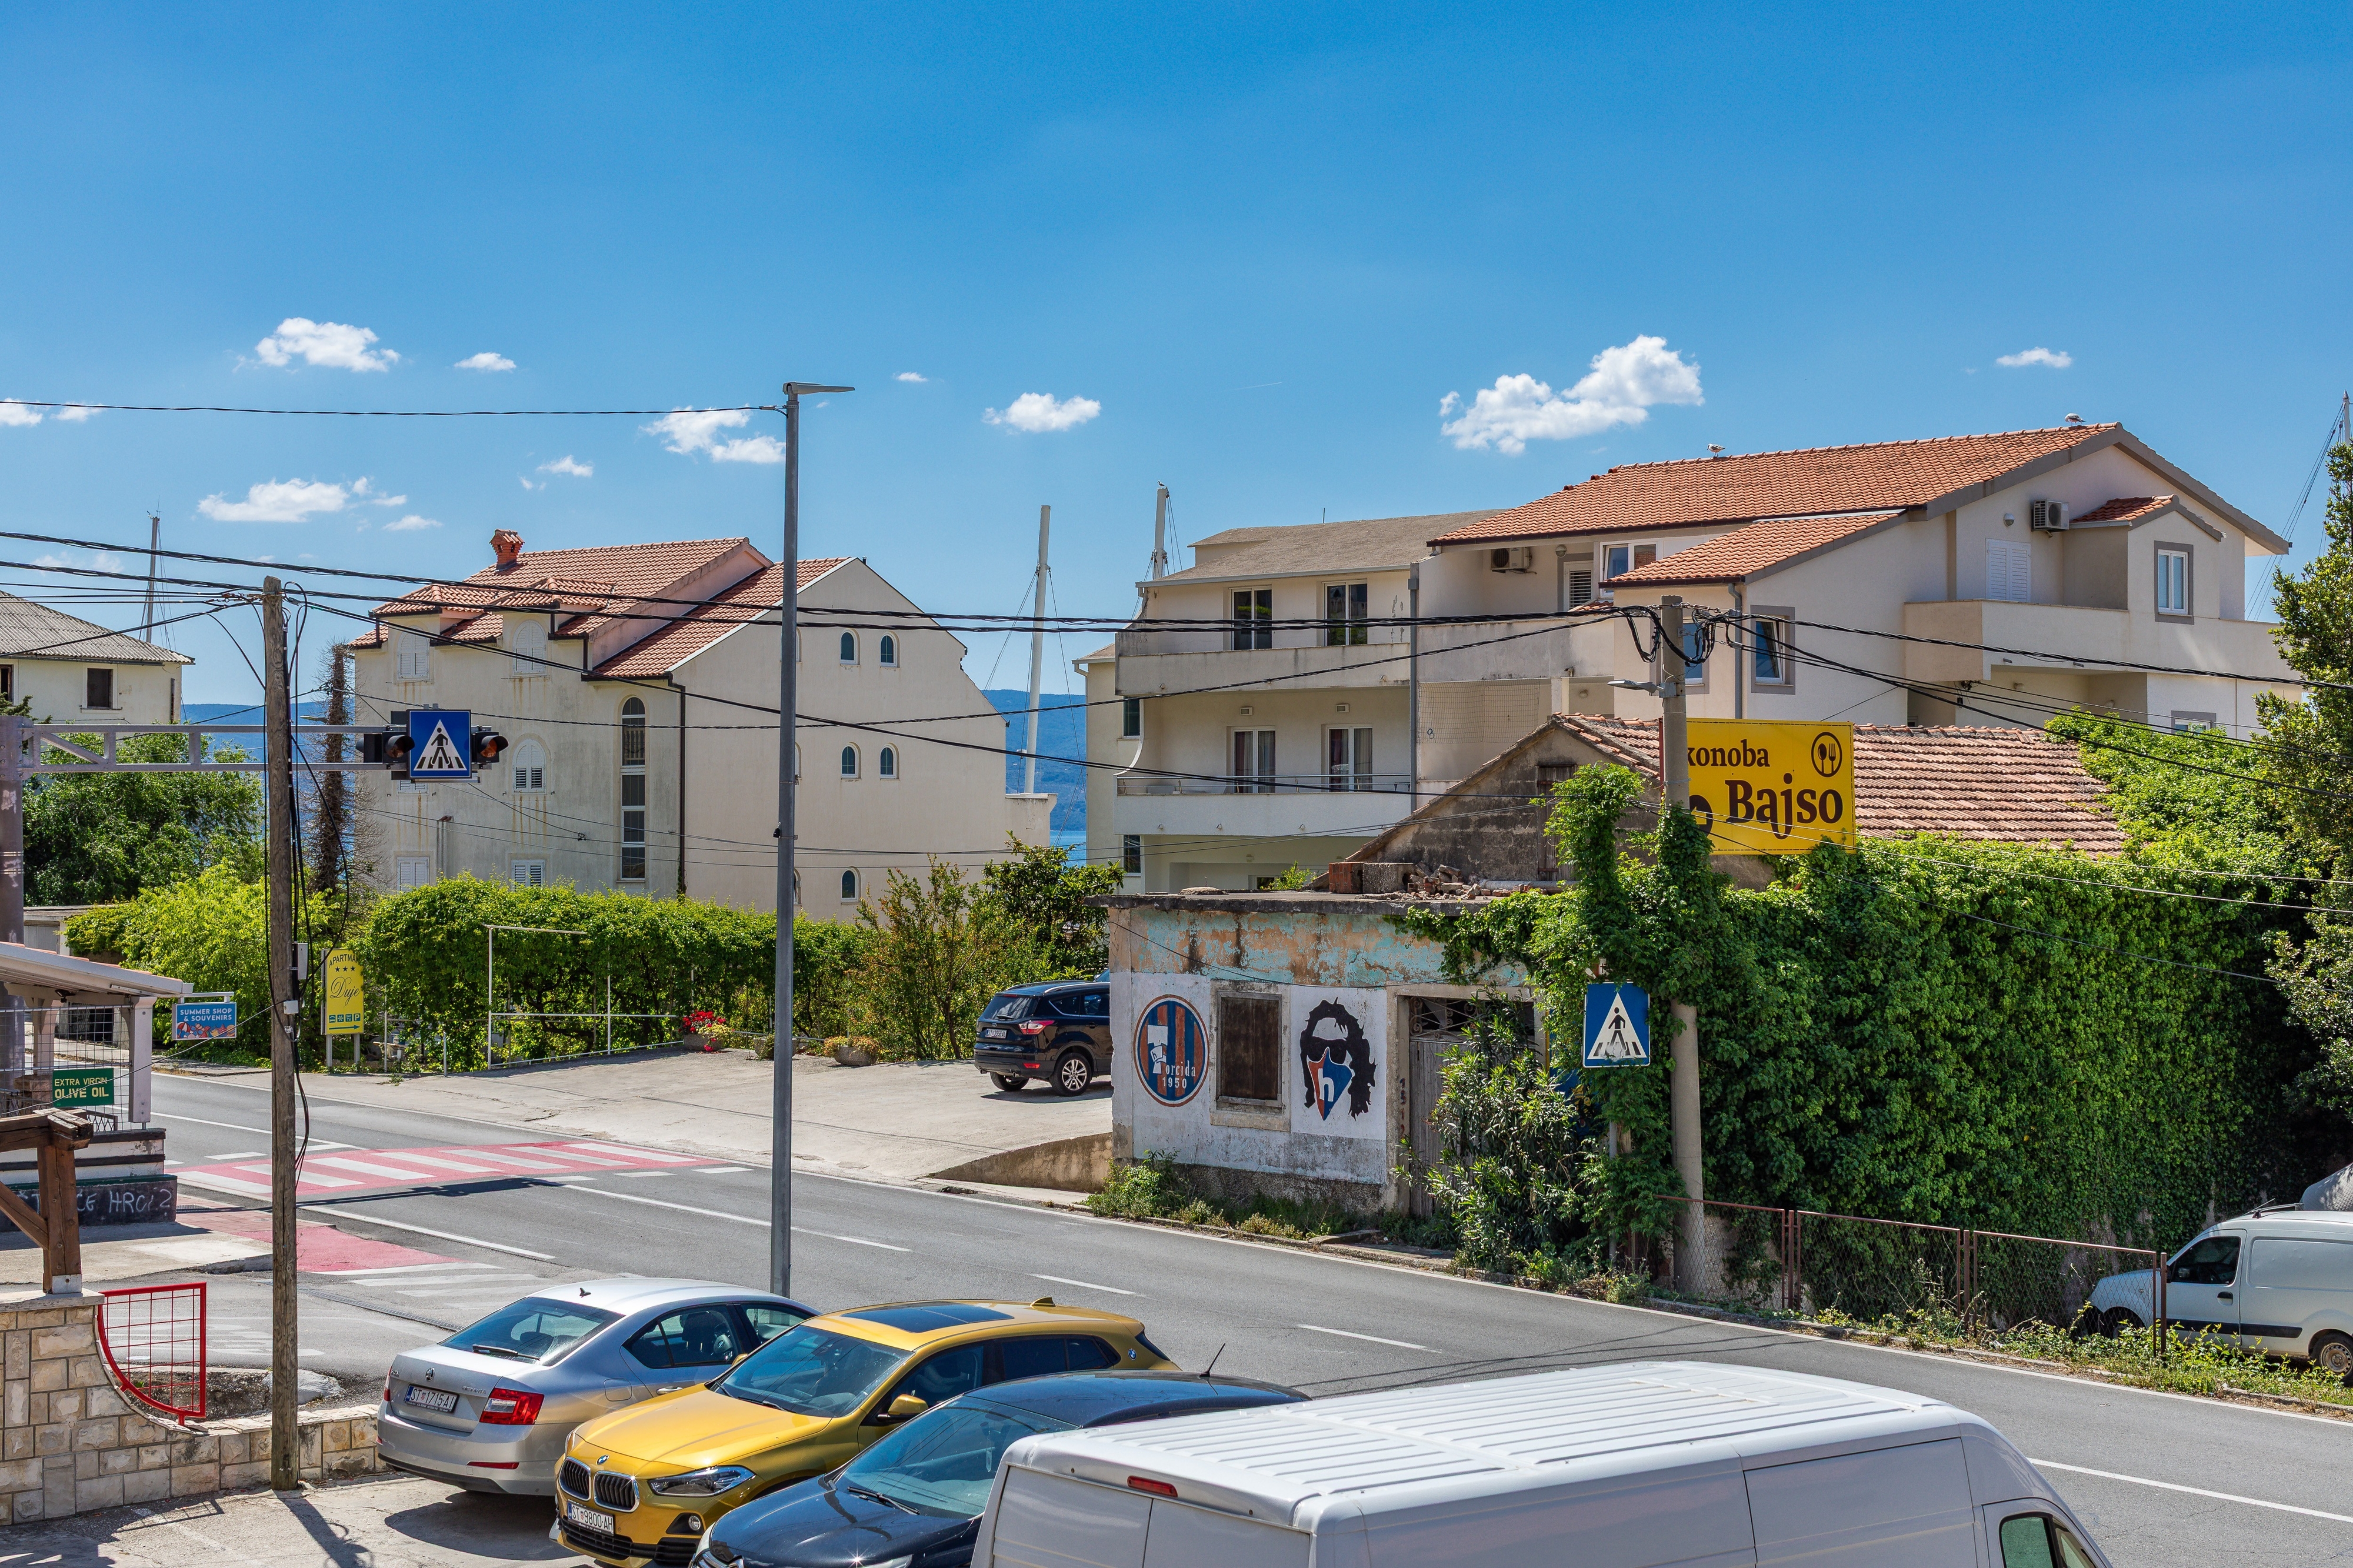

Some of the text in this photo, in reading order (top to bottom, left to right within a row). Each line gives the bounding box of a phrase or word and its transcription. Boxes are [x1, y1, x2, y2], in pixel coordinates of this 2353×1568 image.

[1724, 773, 1844, 840] Bajso
[329, 976, 361, 1006] Duje
[54, 1077, 108, 1086] EXTRA VIRGIN
[1162, 1076, 1187, 1089] 1950
[1318, 1068, 1334, 1102] h
[55, 1087, 109, 1099] OLIVE OIL
[411, 1388, 422, 1402] ST
[572, 1506, 579, 1520] ST
